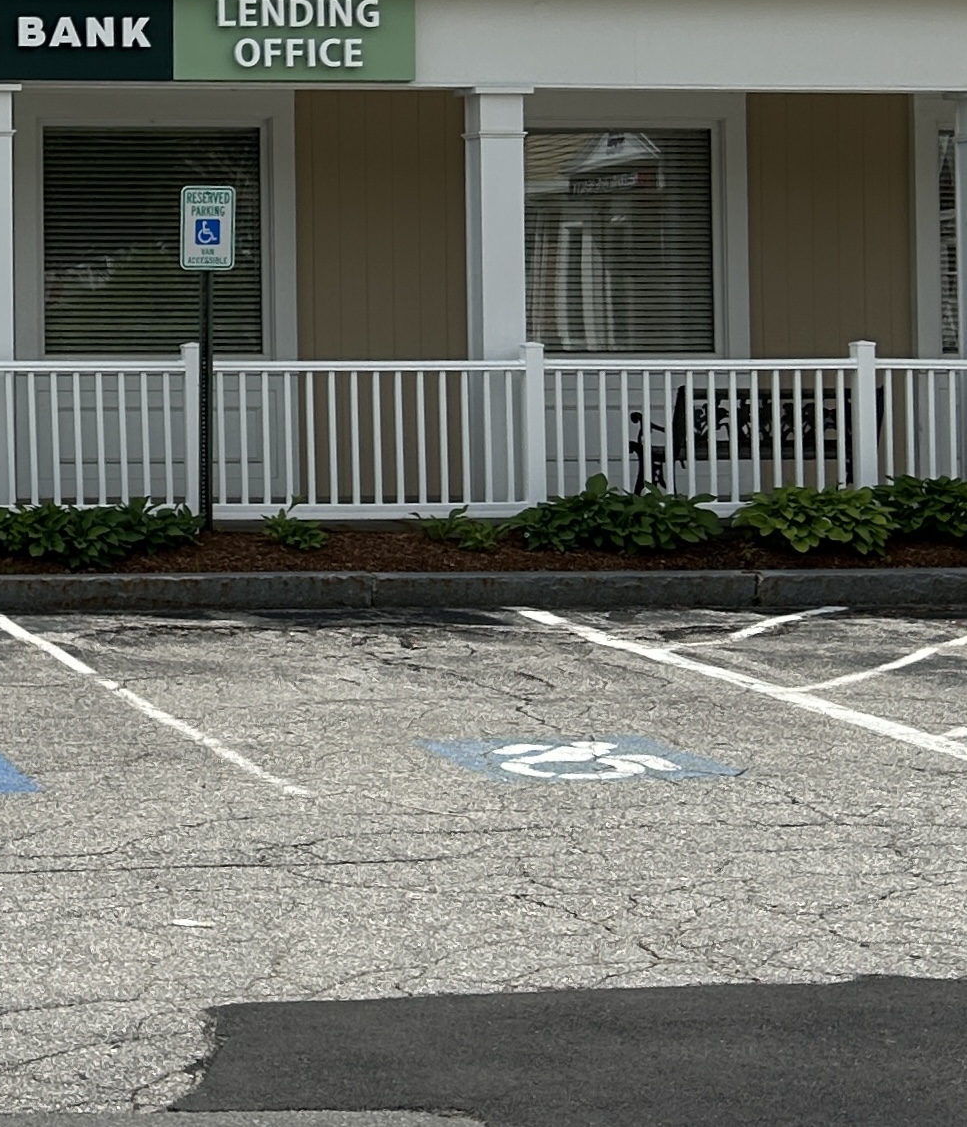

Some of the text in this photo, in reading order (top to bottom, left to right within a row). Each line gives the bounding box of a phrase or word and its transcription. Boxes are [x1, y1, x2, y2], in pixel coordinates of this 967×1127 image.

[17, 16, 152, 48] BANK
[234, 38, 364, 68] OFFICE
[186, 192, 230, 204] RESERVED
[191, 206, 225, 217] PARKING
[201, 248, 215, 256] VAN
[187, 256, 228, 265] ACCESSIBLE
